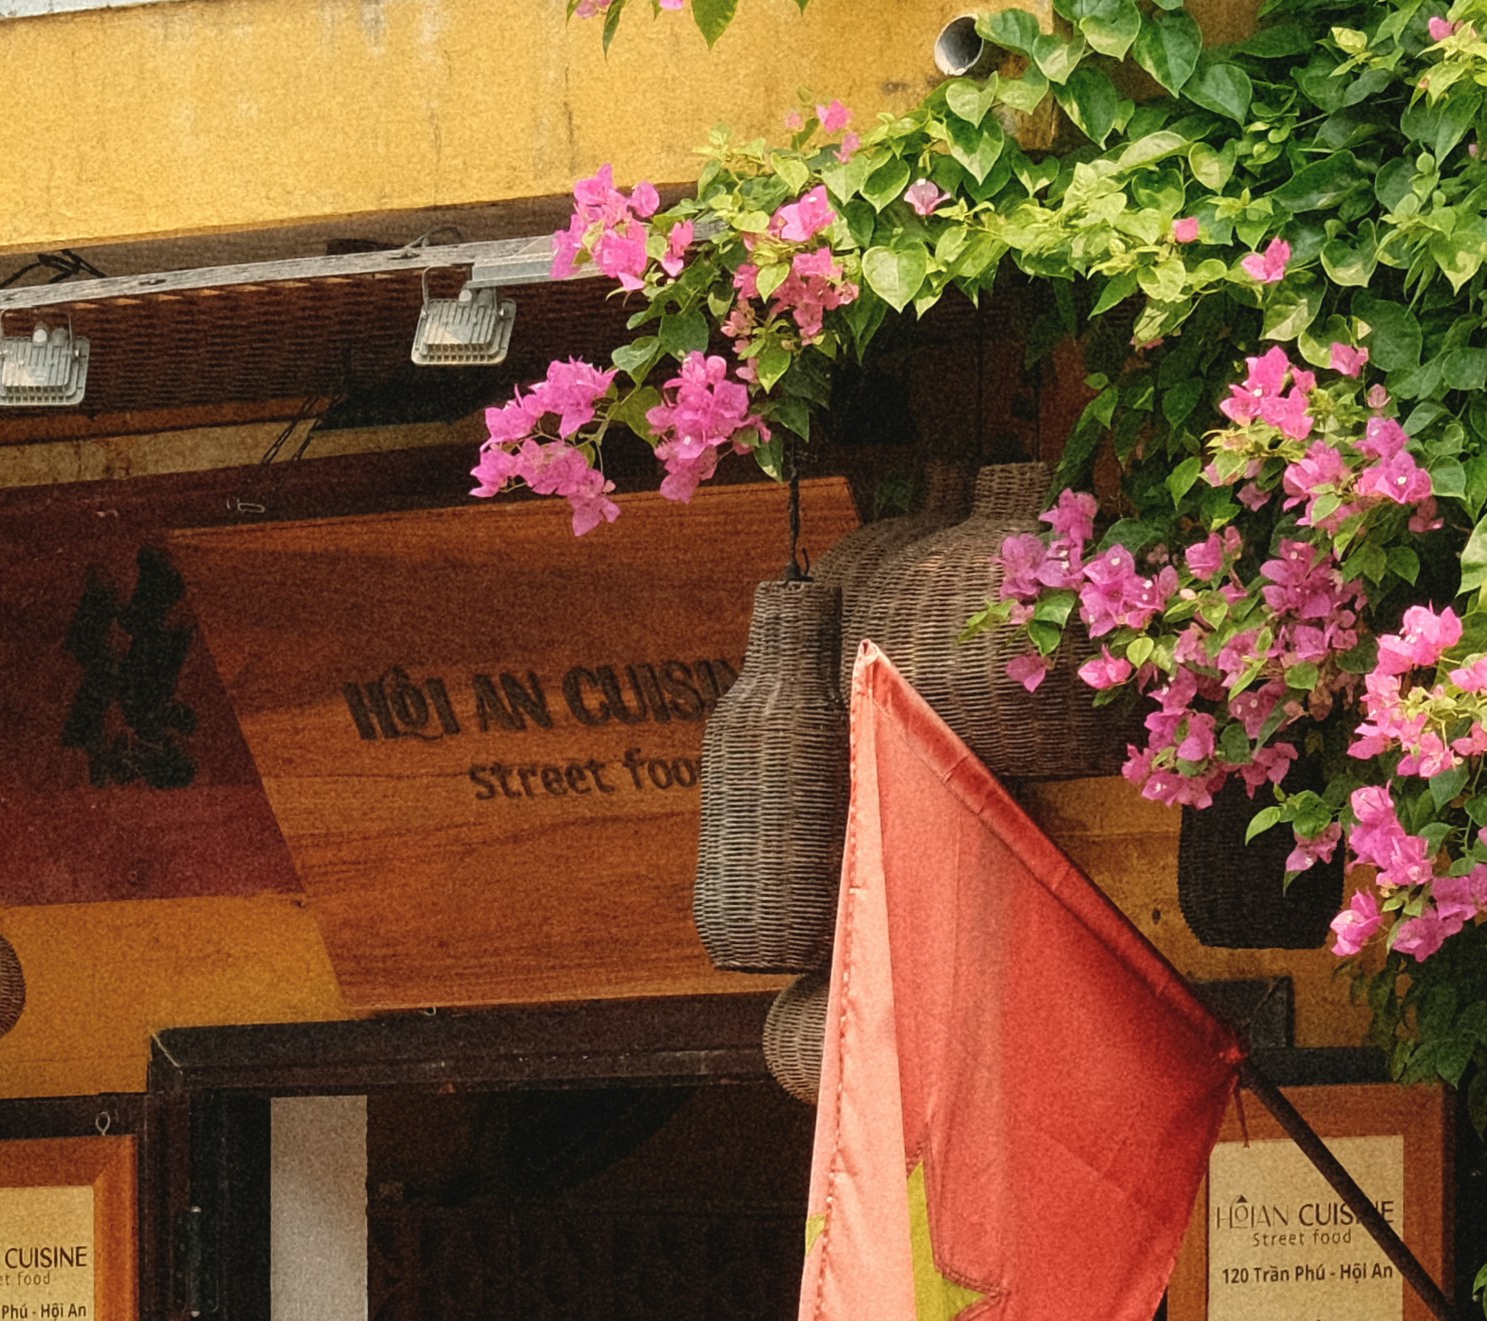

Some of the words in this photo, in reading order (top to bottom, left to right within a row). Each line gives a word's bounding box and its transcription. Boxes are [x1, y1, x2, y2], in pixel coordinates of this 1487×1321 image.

[472, 671, 554, 733] AN
[468, 756, 616, 801] street
[622, 748, 702, 792] foo
[1298, 1201, 1394, 1226] CUISE
[1253, 1232, 1304, 1247] Street
[1313, 1229, 1351, 1245] food
[5, 1246, 87, 1269] CUISINE
[17, 1272, 51, 1286] food
[1223, 1268, 1249, 1284] 120
[1295, 1264, 1325, 1281] Phú
[1340, 1264, 1366, 1283] Hội
[1371, 1263, 1393, 1279] An
[2, 1304, 28, 1319] Phú
[41, 1303, 63, 1321] Hội
[68, 1304, 87, 1317] An
